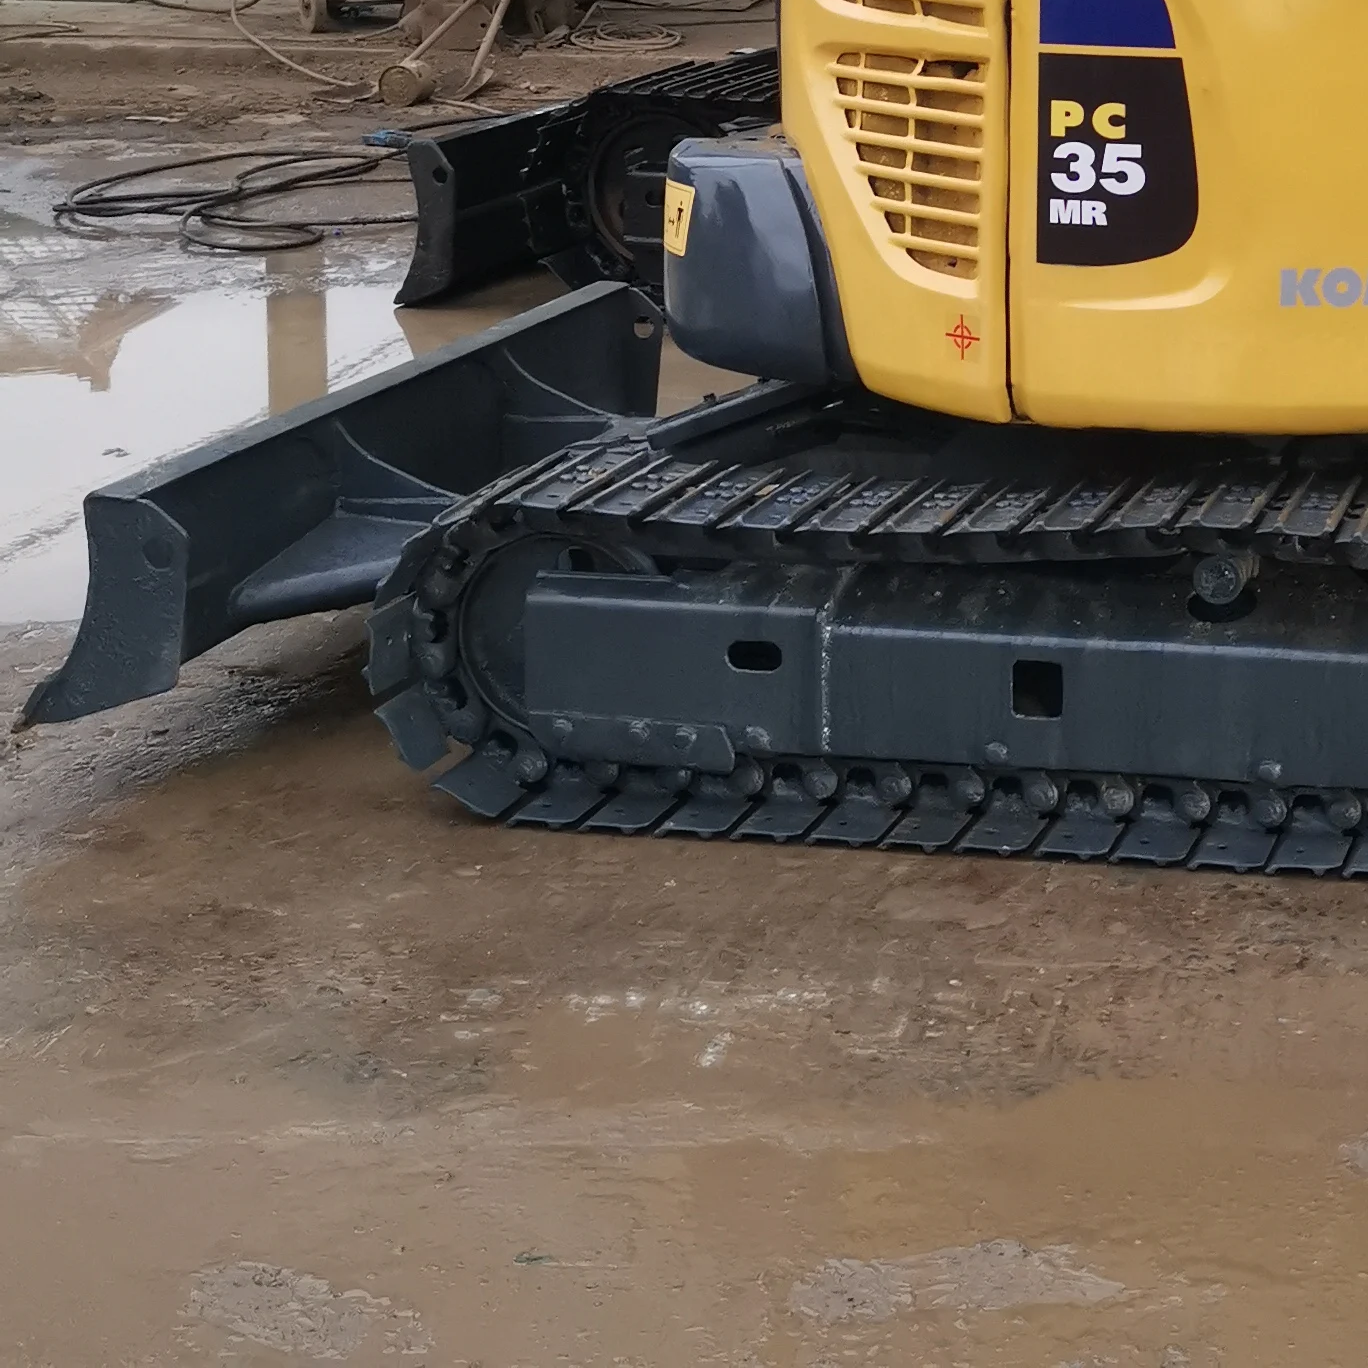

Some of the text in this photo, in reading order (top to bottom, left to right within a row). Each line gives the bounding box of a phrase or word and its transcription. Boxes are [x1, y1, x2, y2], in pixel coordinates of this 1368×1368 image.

[1050, 99, 1126, 140] PC
[1050, 141, 1146, 196] 35
[1049, 198, 1108, 226] MR
